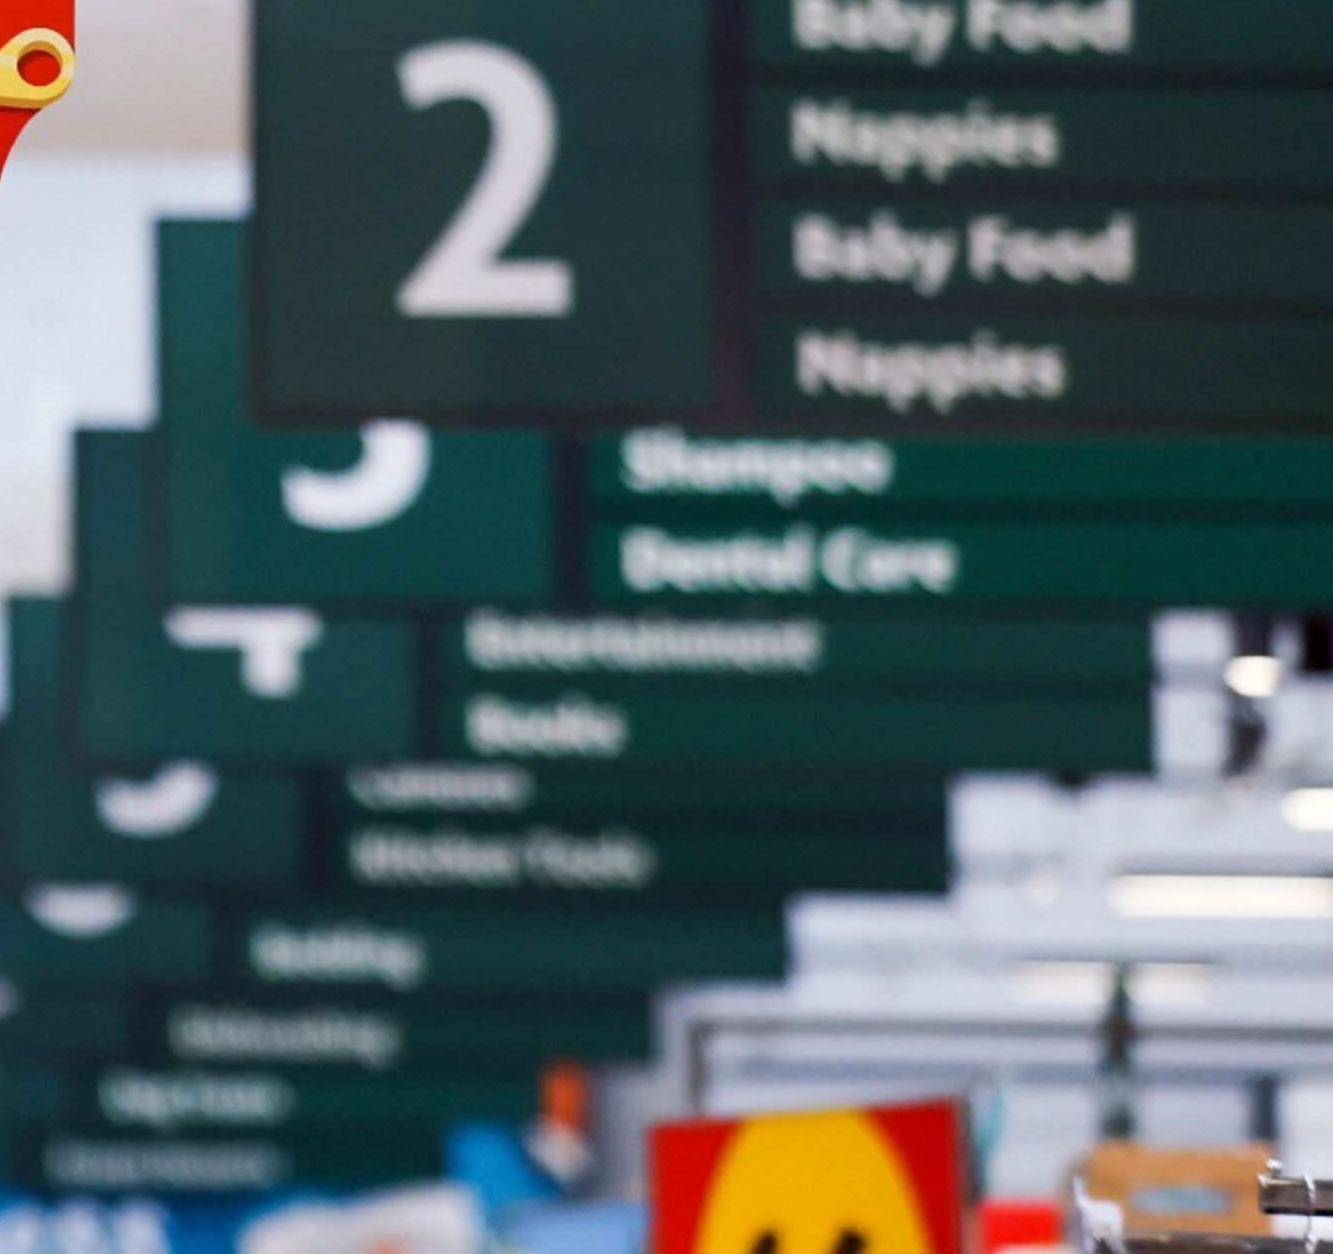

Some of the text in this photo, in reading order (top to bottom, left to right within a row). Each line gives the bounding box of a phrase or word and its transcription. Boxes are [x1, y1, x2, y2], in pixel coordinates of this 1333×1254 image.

[395, 37, 575, 317] 2
[790, 97, 1060, 184] Nappies
[793, 209, 1135, 298] Baby Food
[794, 327, 1067, 415] Nappies
[621, 424, 895, 509] Shampoo
[621, 521, 961, 592] Dental Care
[464, 690, 628, 757] Books
